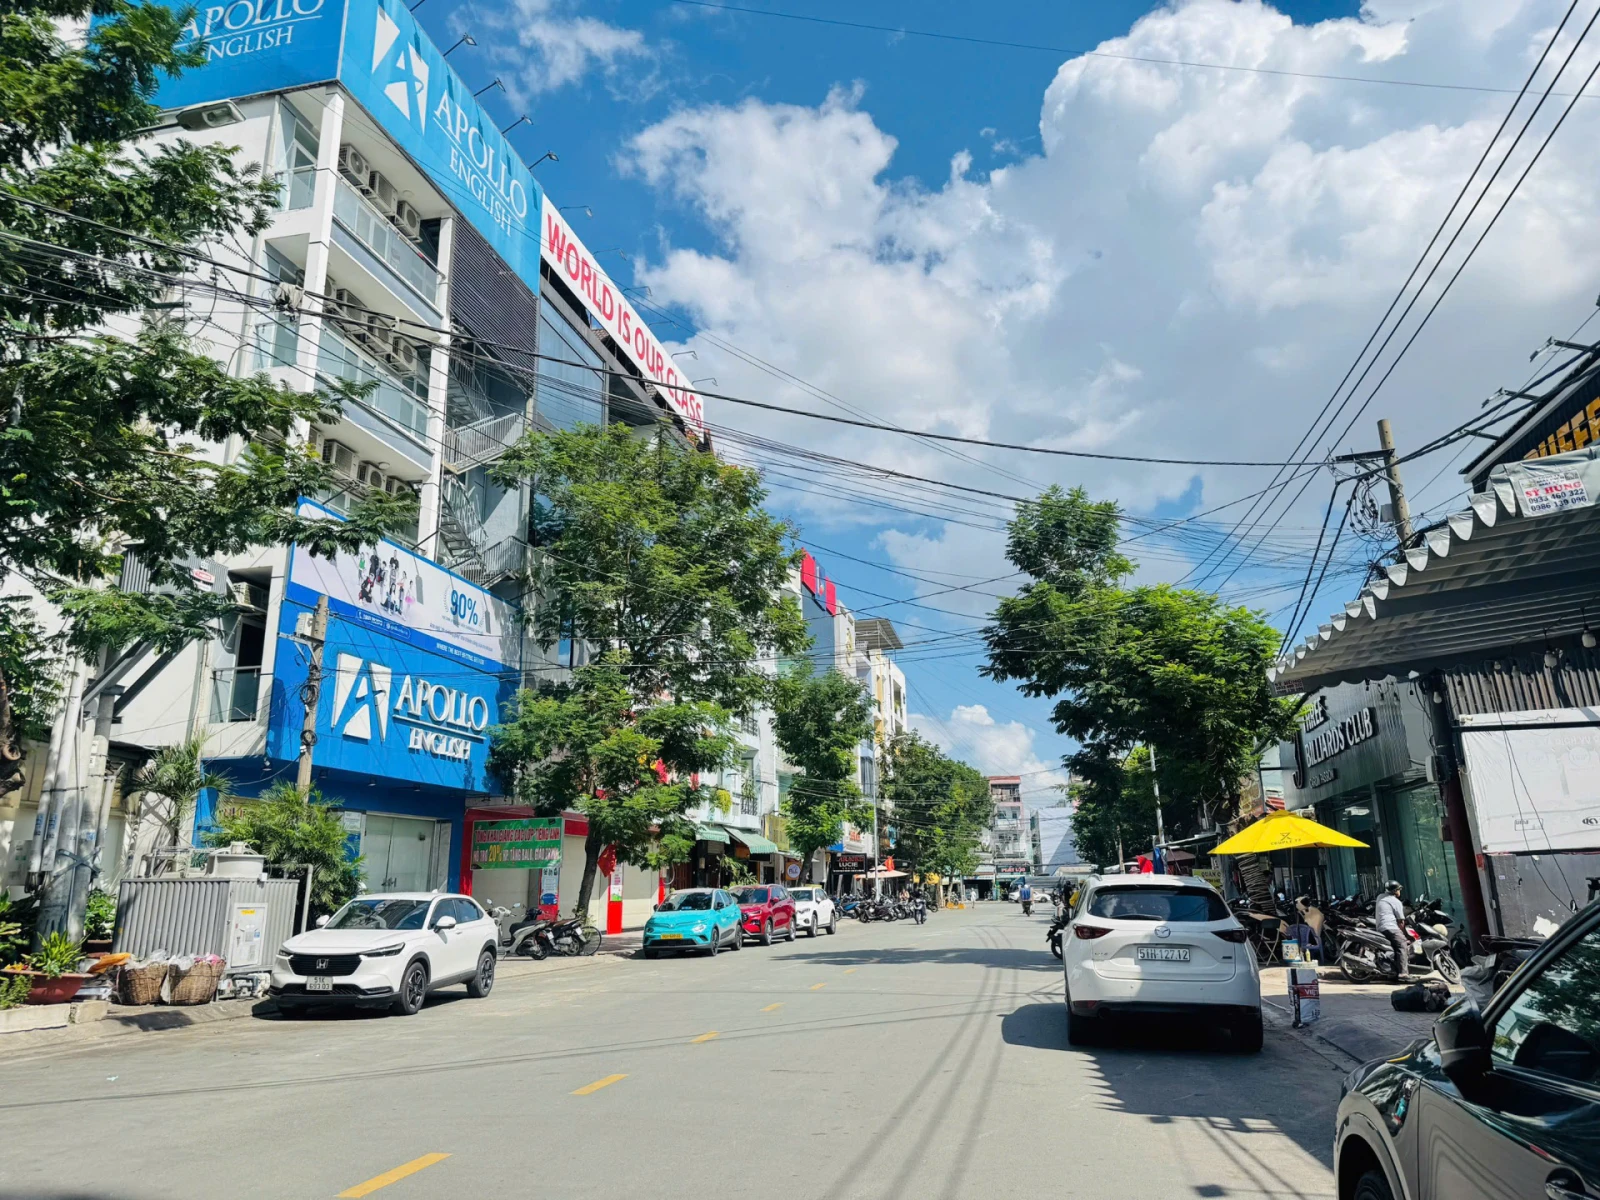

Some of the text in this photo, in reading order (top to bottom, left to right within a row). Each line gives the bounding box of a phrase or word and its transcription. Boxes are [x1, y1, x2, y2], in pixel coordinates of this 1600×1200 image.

[203, 25, 294, 62] NGLISH
[433, 88, 528, 219] APOLLO
[449, 151, 512, 238] ENGLISH
[547, 213, 702, 429] WORLD IS OUR CLASS
[1568, 487, 1585, 497] 322
[450, 588, 478, 626] 90%
[393, 674, 489, 732] APOLLO
[409, 727, 471, 760] ENGLISH
[1304, 707, 1373, 768] BILLIARDS CLUB
